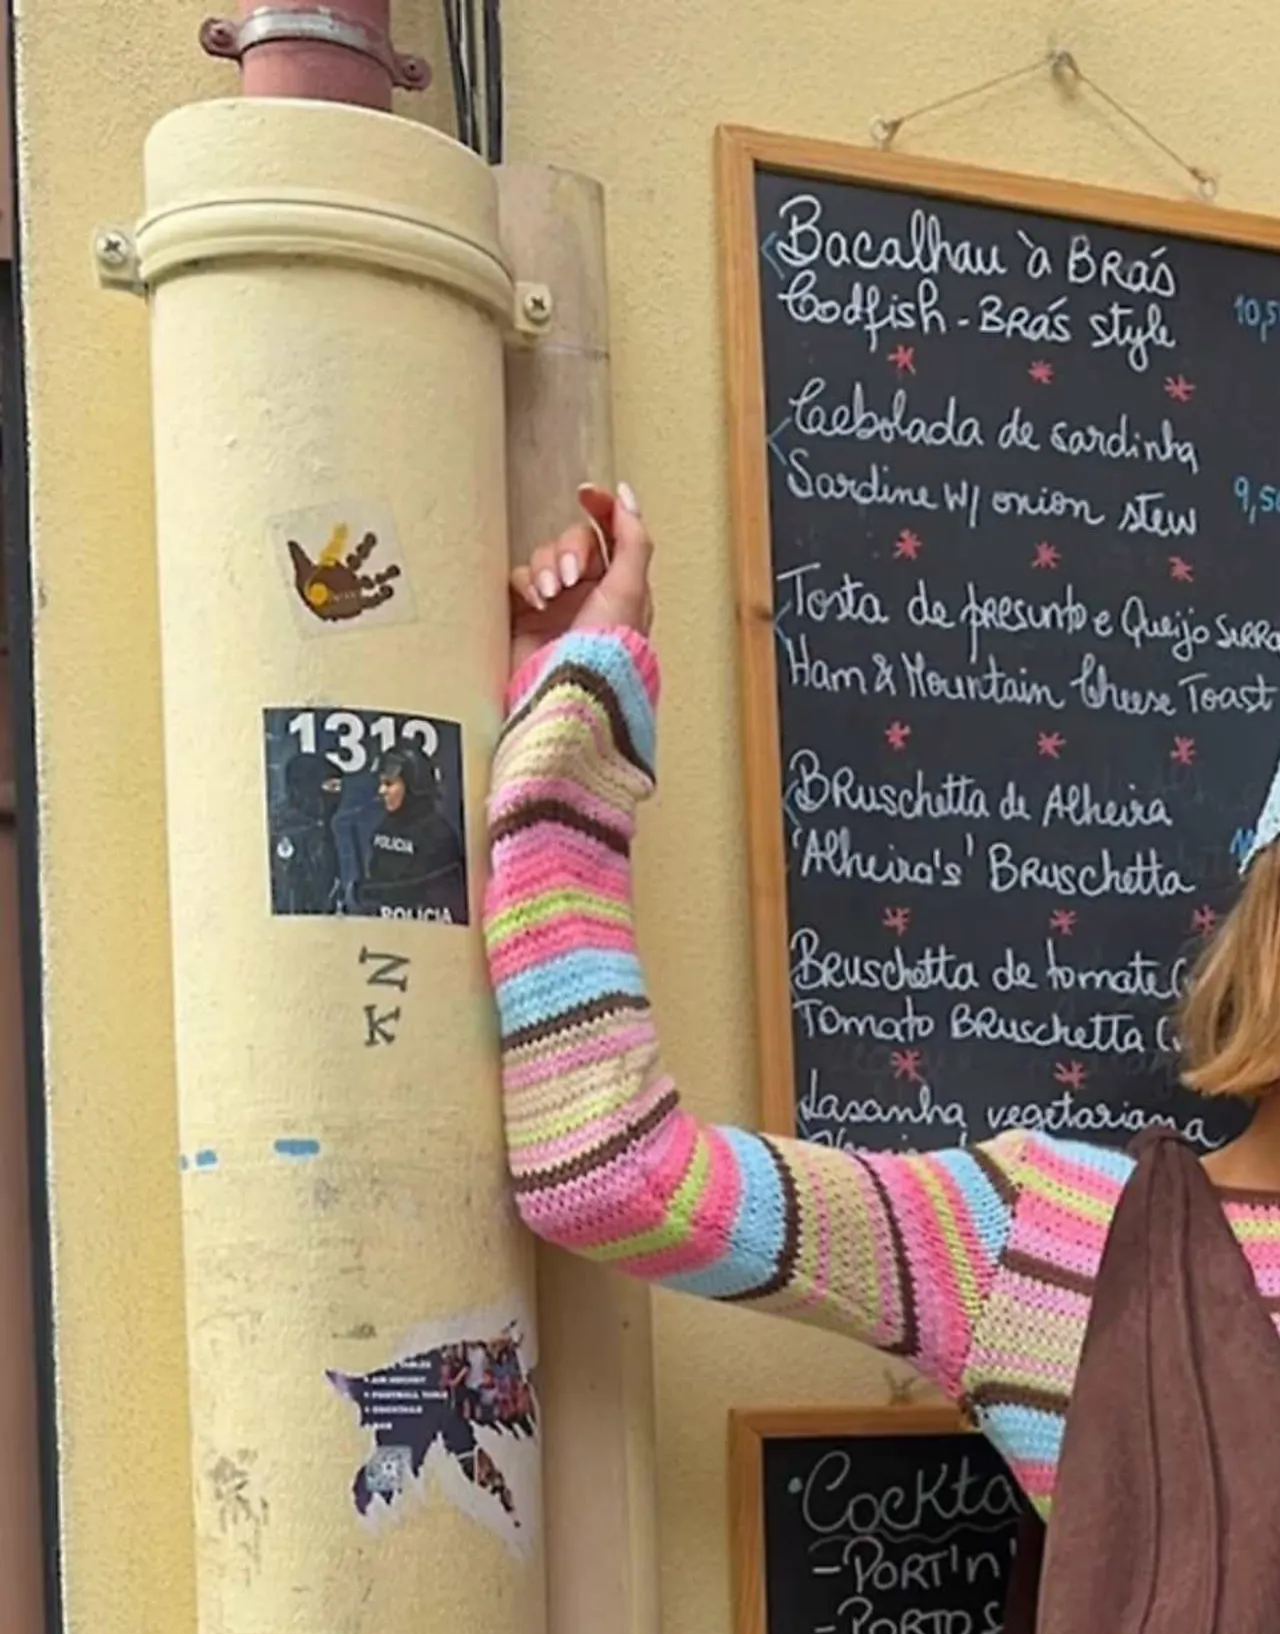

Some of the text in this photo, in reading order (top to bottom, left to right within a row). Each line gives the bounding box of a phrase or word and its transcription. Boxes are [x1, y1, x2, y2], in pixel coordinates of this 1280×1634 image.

[777, 194, 1007, 275] Bacalhau
[1017, 228, 1052, 279] à
[777, 269, 947, 352] Codfish
[1089, 302, 1176, 373] style
[998, 406, 1041, 450] de
[788, 448, 938, 509] Sardine
[991, 486, 1105, 526] onion
[1117, 491, 1197, 537] stew
[777, 562, 890, 624] Tosta
[907, 578, 956, 629] de
[1121, 596, 1211, 662] Queijo
[786, 634, 868, 695] Ham
[872, 653, 897, 696] &
[901, 650, 1065, 709] Mountain
[1177, 672, 1279, 715] Toast
[999, 780, 1032, 821] de
[1042, 783, 1173, 828] Alheira
[992, 946, 1038, 991] de
[793, 995, 934, 1042] Tomato
[802, 1450, 1024, 1533] Cockta
